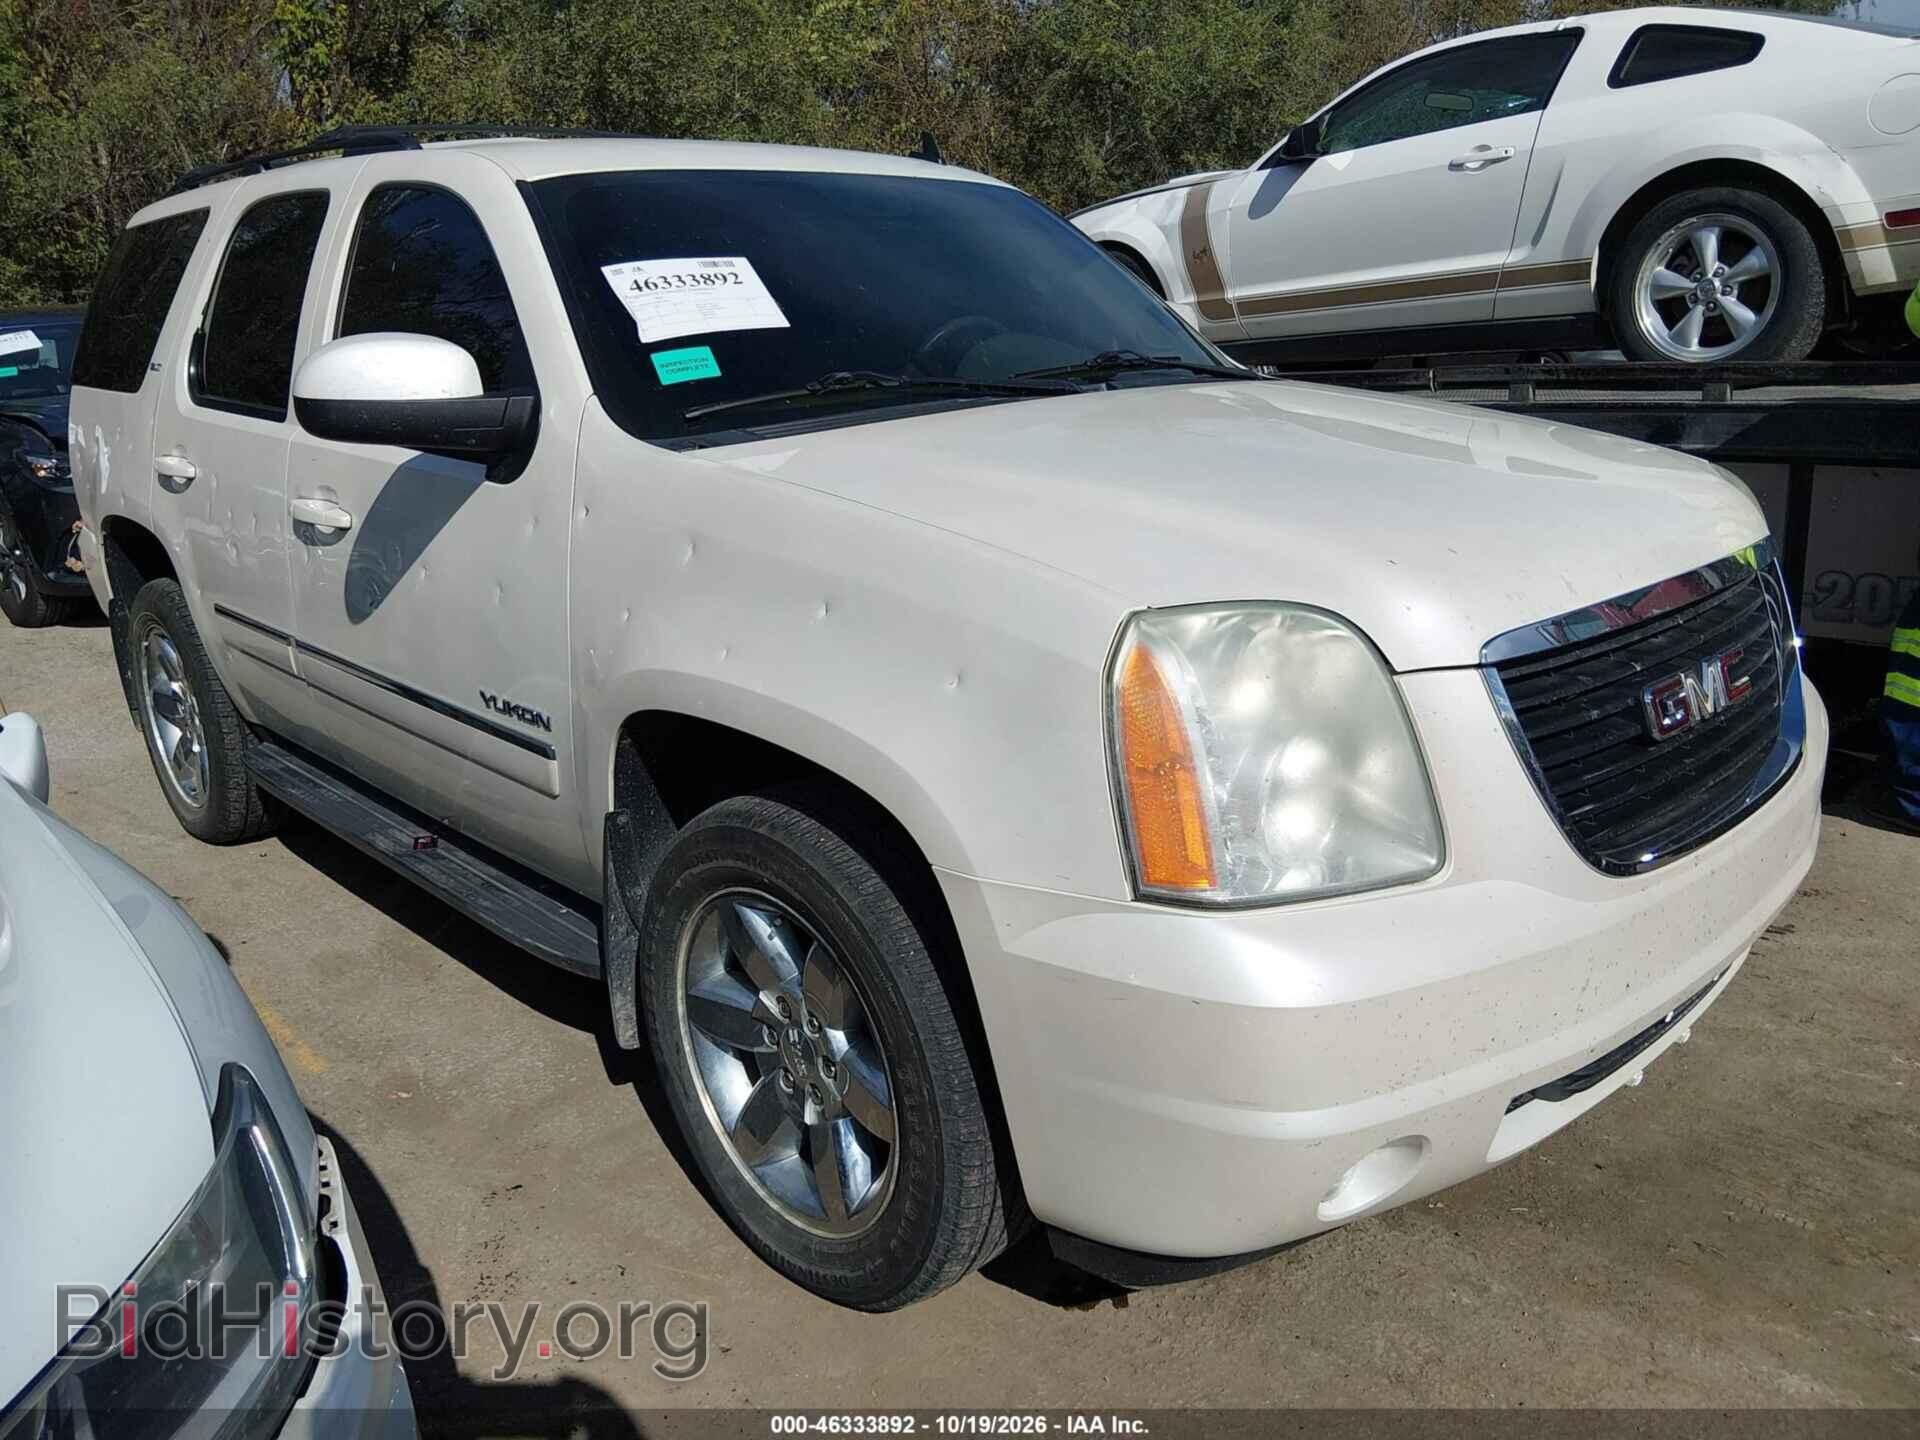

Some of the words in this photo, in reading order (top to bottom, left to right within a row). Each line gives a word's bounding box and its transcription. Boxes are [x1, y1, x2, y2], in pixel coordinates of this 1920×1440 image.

[629, 271, 744, 292] 46333892
[479, 689, 552, 733] YUKON
[1641, 649, 1752, 740] GMC
